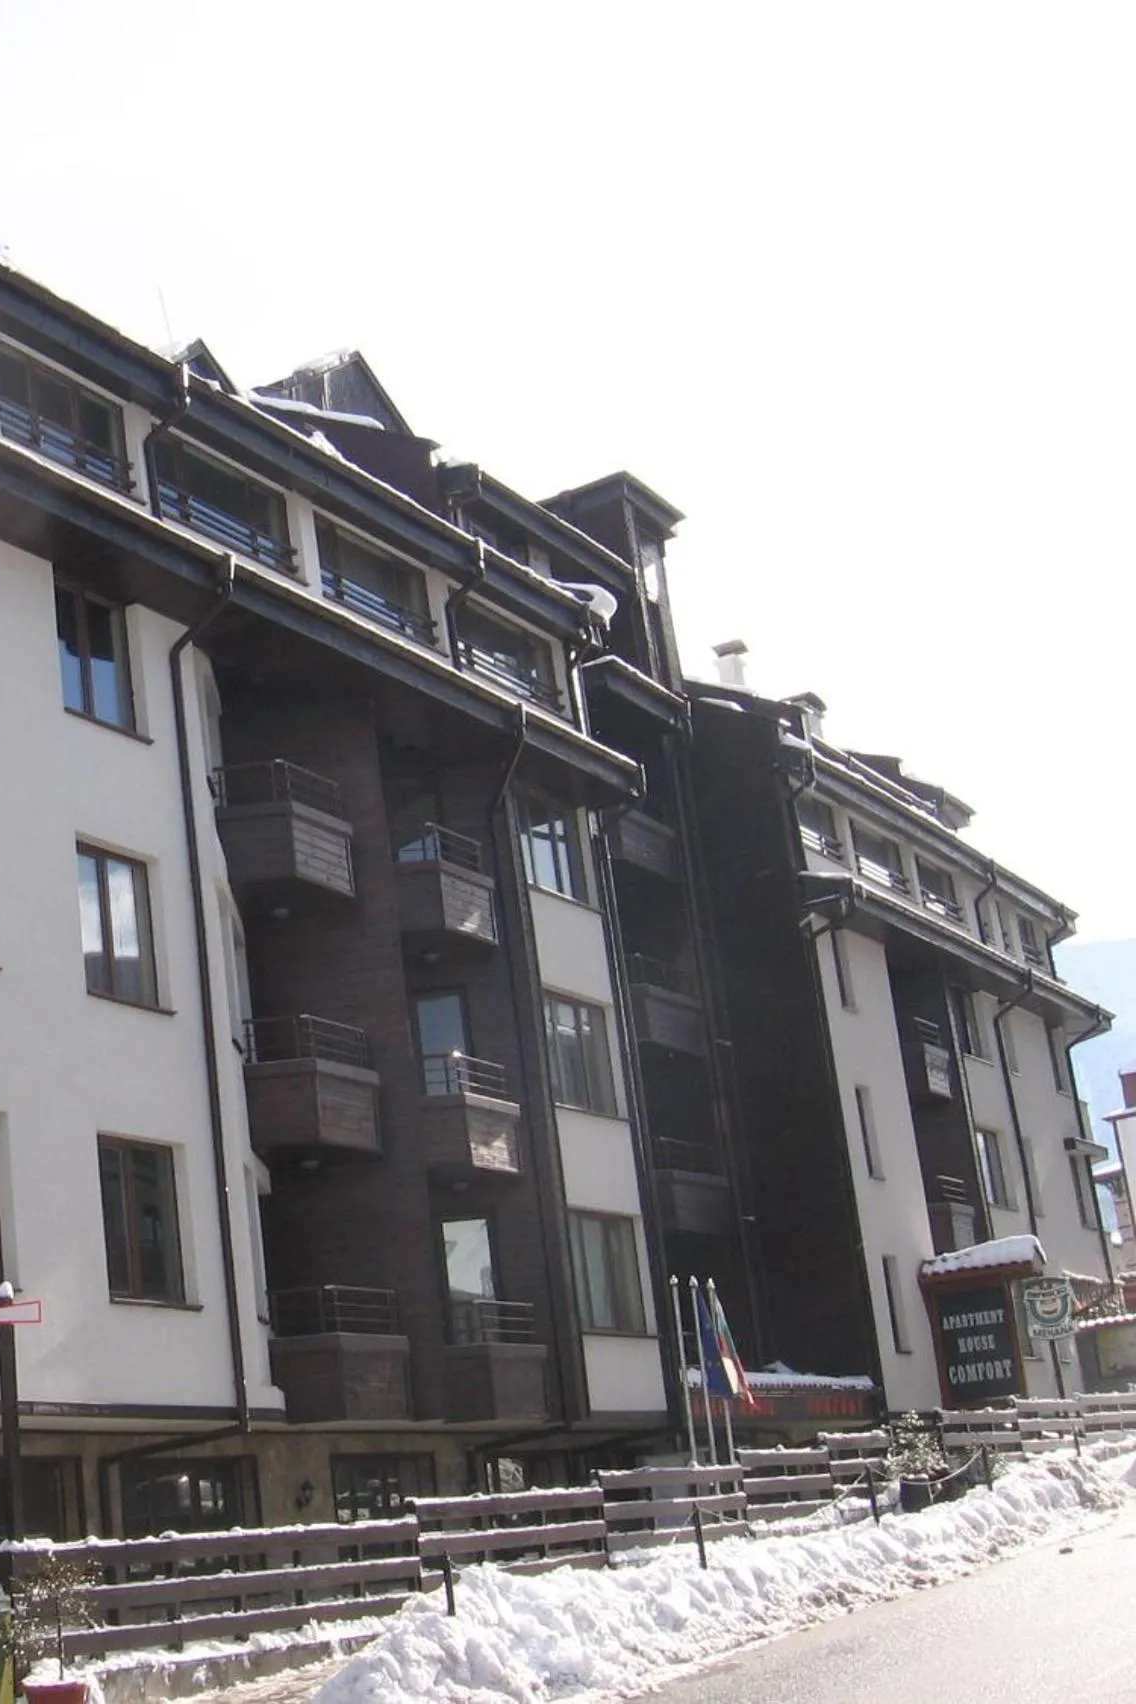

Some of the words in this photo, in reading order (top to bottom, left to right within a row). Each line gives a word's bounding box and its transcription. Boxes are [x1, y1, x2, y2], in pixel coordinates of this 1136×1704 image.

[942, 1308, 1005, 1330] APARTMENT
[958, 1334, 996, 1353] HOUSE
[948, 1359, 1013, 1385] COMFORT
